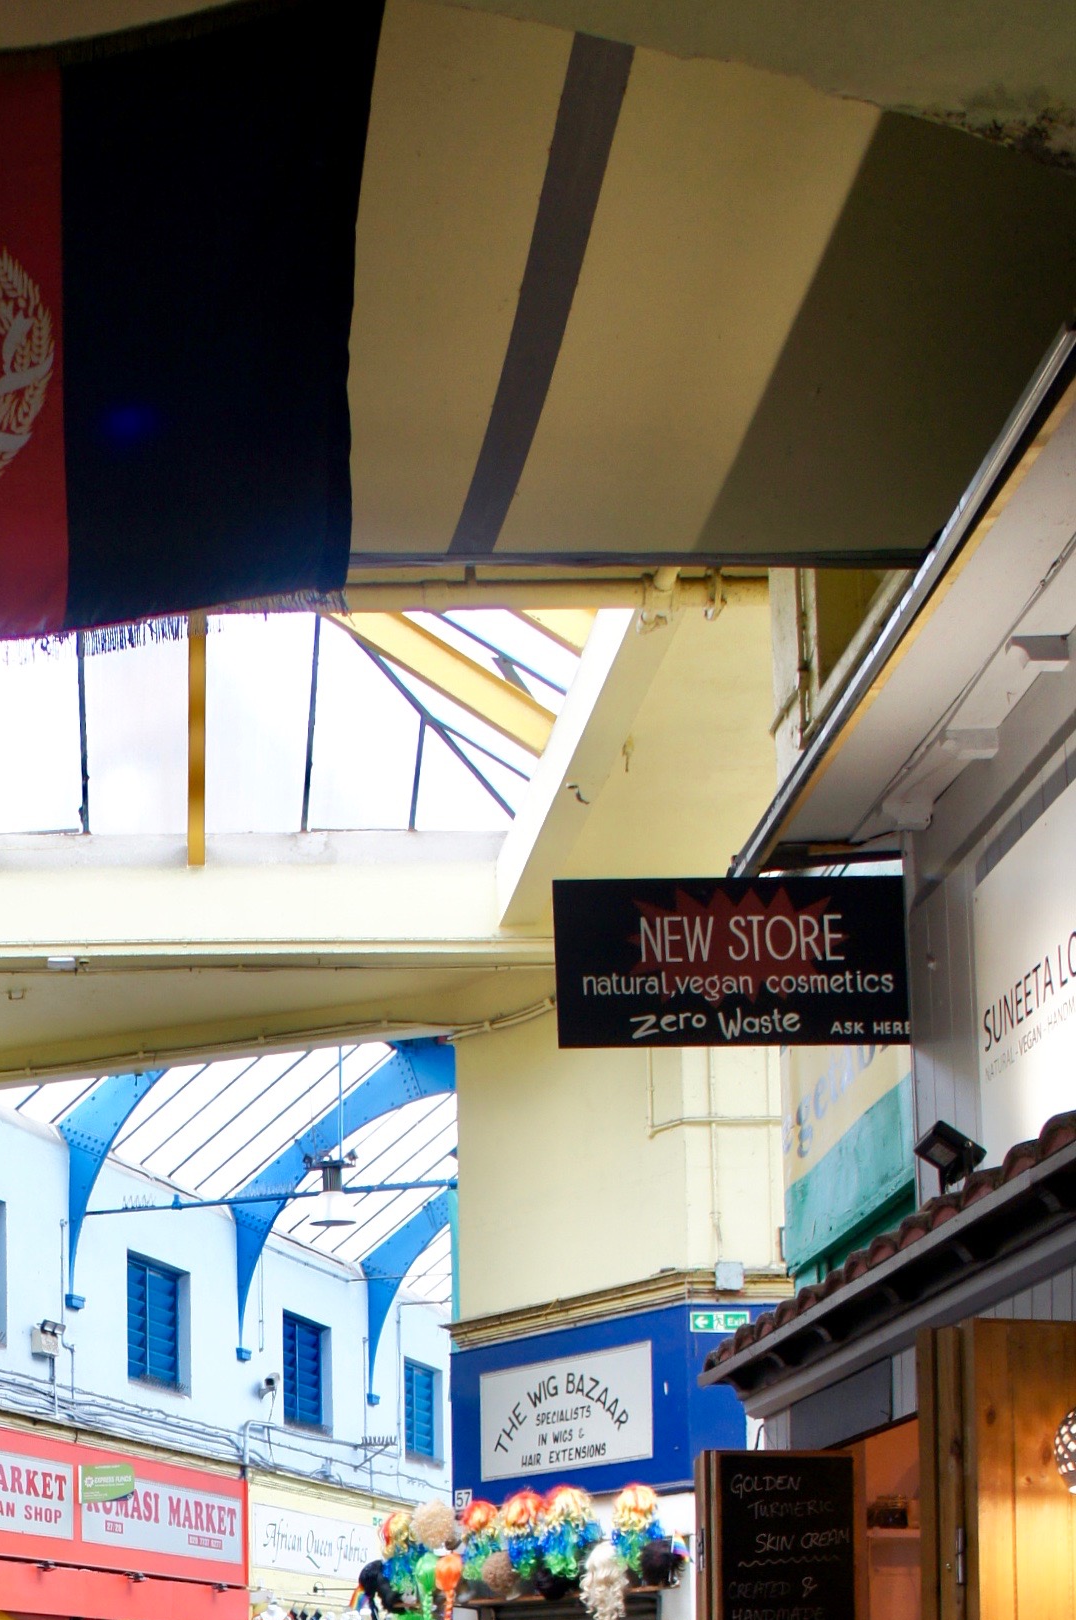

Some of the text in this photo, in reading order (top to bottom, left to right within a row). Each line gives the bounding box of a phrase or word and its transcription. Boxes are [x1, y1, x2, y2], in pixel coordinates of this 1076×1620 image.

[639, 913, 846, 963] NEW STORE
[765, 970, 895, 995] cosmetics
[983, 955, 1055, 1052] SUNEETA
[718, 1007, 802, 1040] Waste
[829, 1020, 866, 1035] ASK
[494, 1372, 629, 1453] THE WIG BAZAAR
[535, 1404, 592, 1427] SPECIALISTS
[538, 1434, 547, 1447] IN
[521, 1442, 607, 1467] HAIR EXTENSIONS
[730, 1472, 802, 1499] GOLDEN
[456, 1491, 471, 1508] 57
[747, 1499, 834, 1519] TURMERIC
[23, 1504, 63, 1525] SHOP
[168, 1495, 237, 1537] MARKET
[262, 1517, 369, 1572] African Queen Fabrics
[755, 1528, 851, 1554] SKIN CREAM
